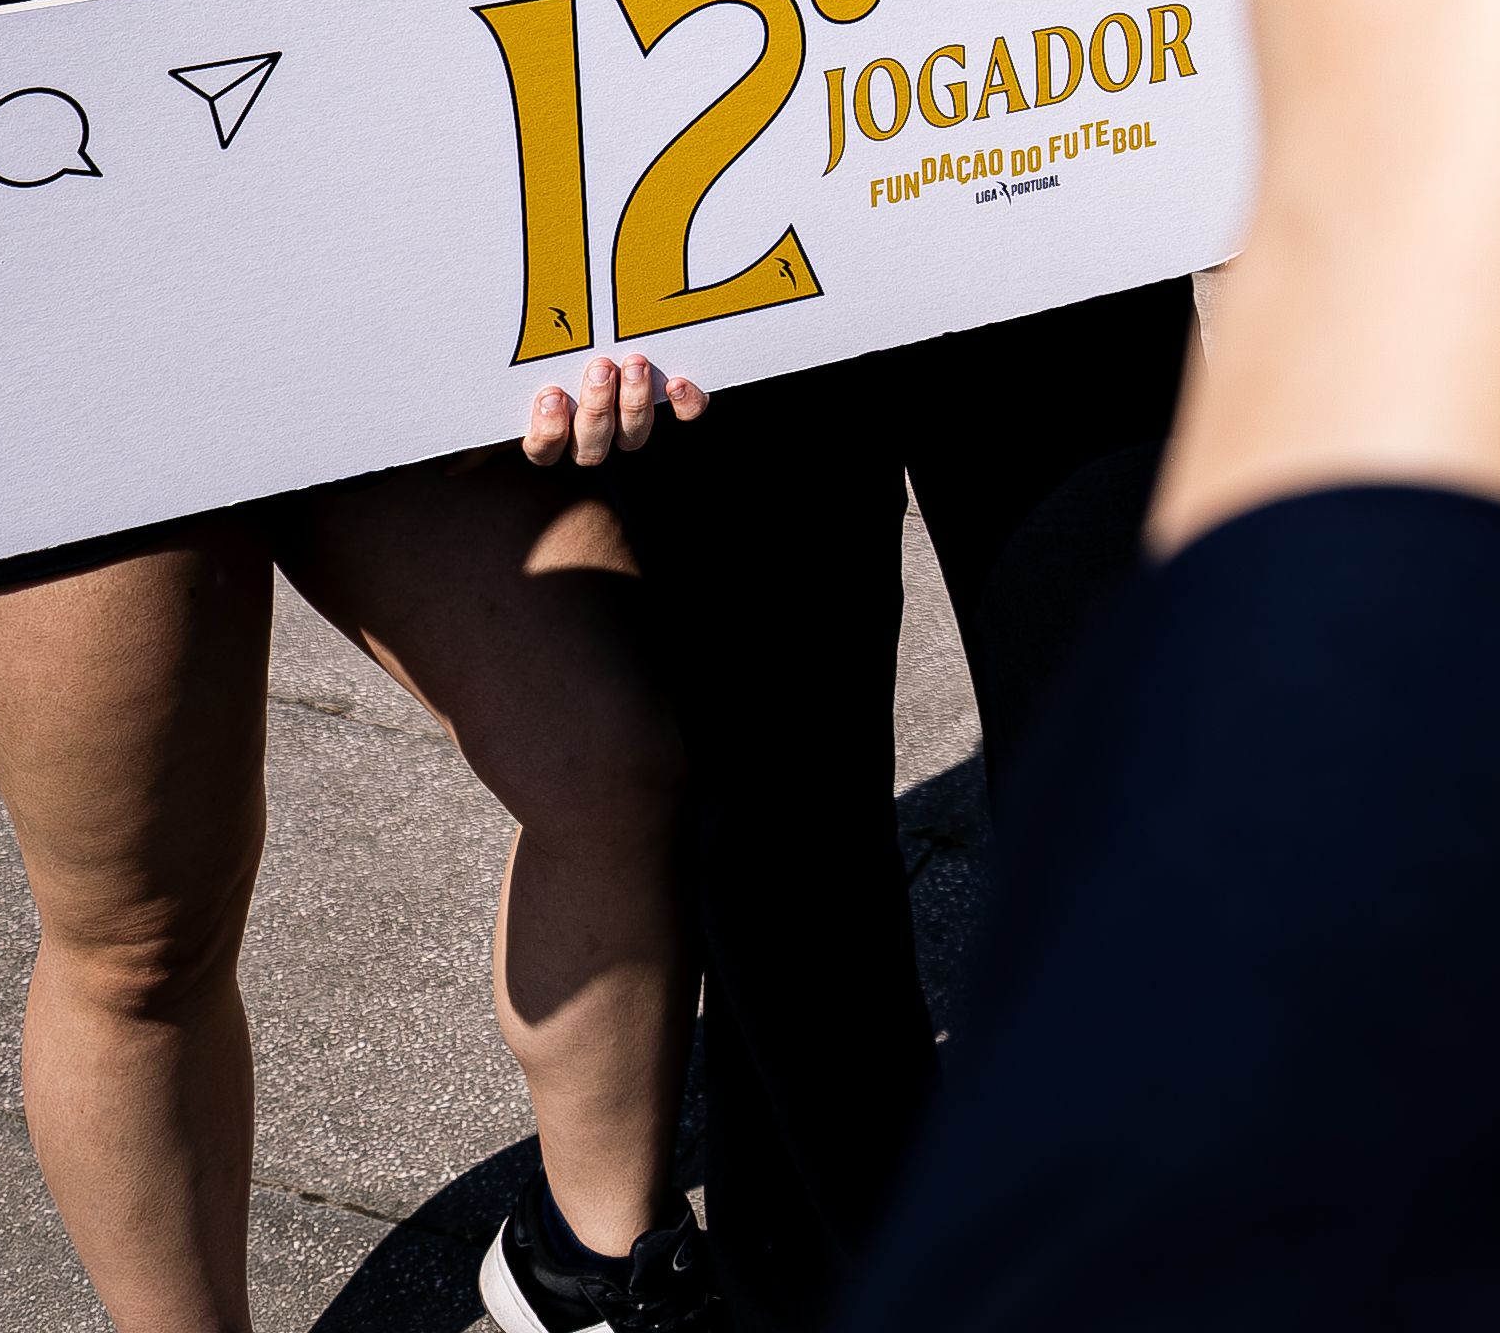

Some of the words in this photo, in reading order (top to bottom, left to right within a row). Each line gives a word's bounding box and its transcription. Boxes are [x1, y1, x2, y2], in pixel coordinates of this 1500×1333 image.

[822, 2, 1198, 178] JOGADOR
[870, 148, 1004, 208] FUNDAÇÃO
[1011, 145, 1042, 177] DO
[1048, 119, 1158, 163] FUTEBOL
[975, 187, 999, 205] LIGA
[1011, 174, 1062, 197] PORTUGAL
